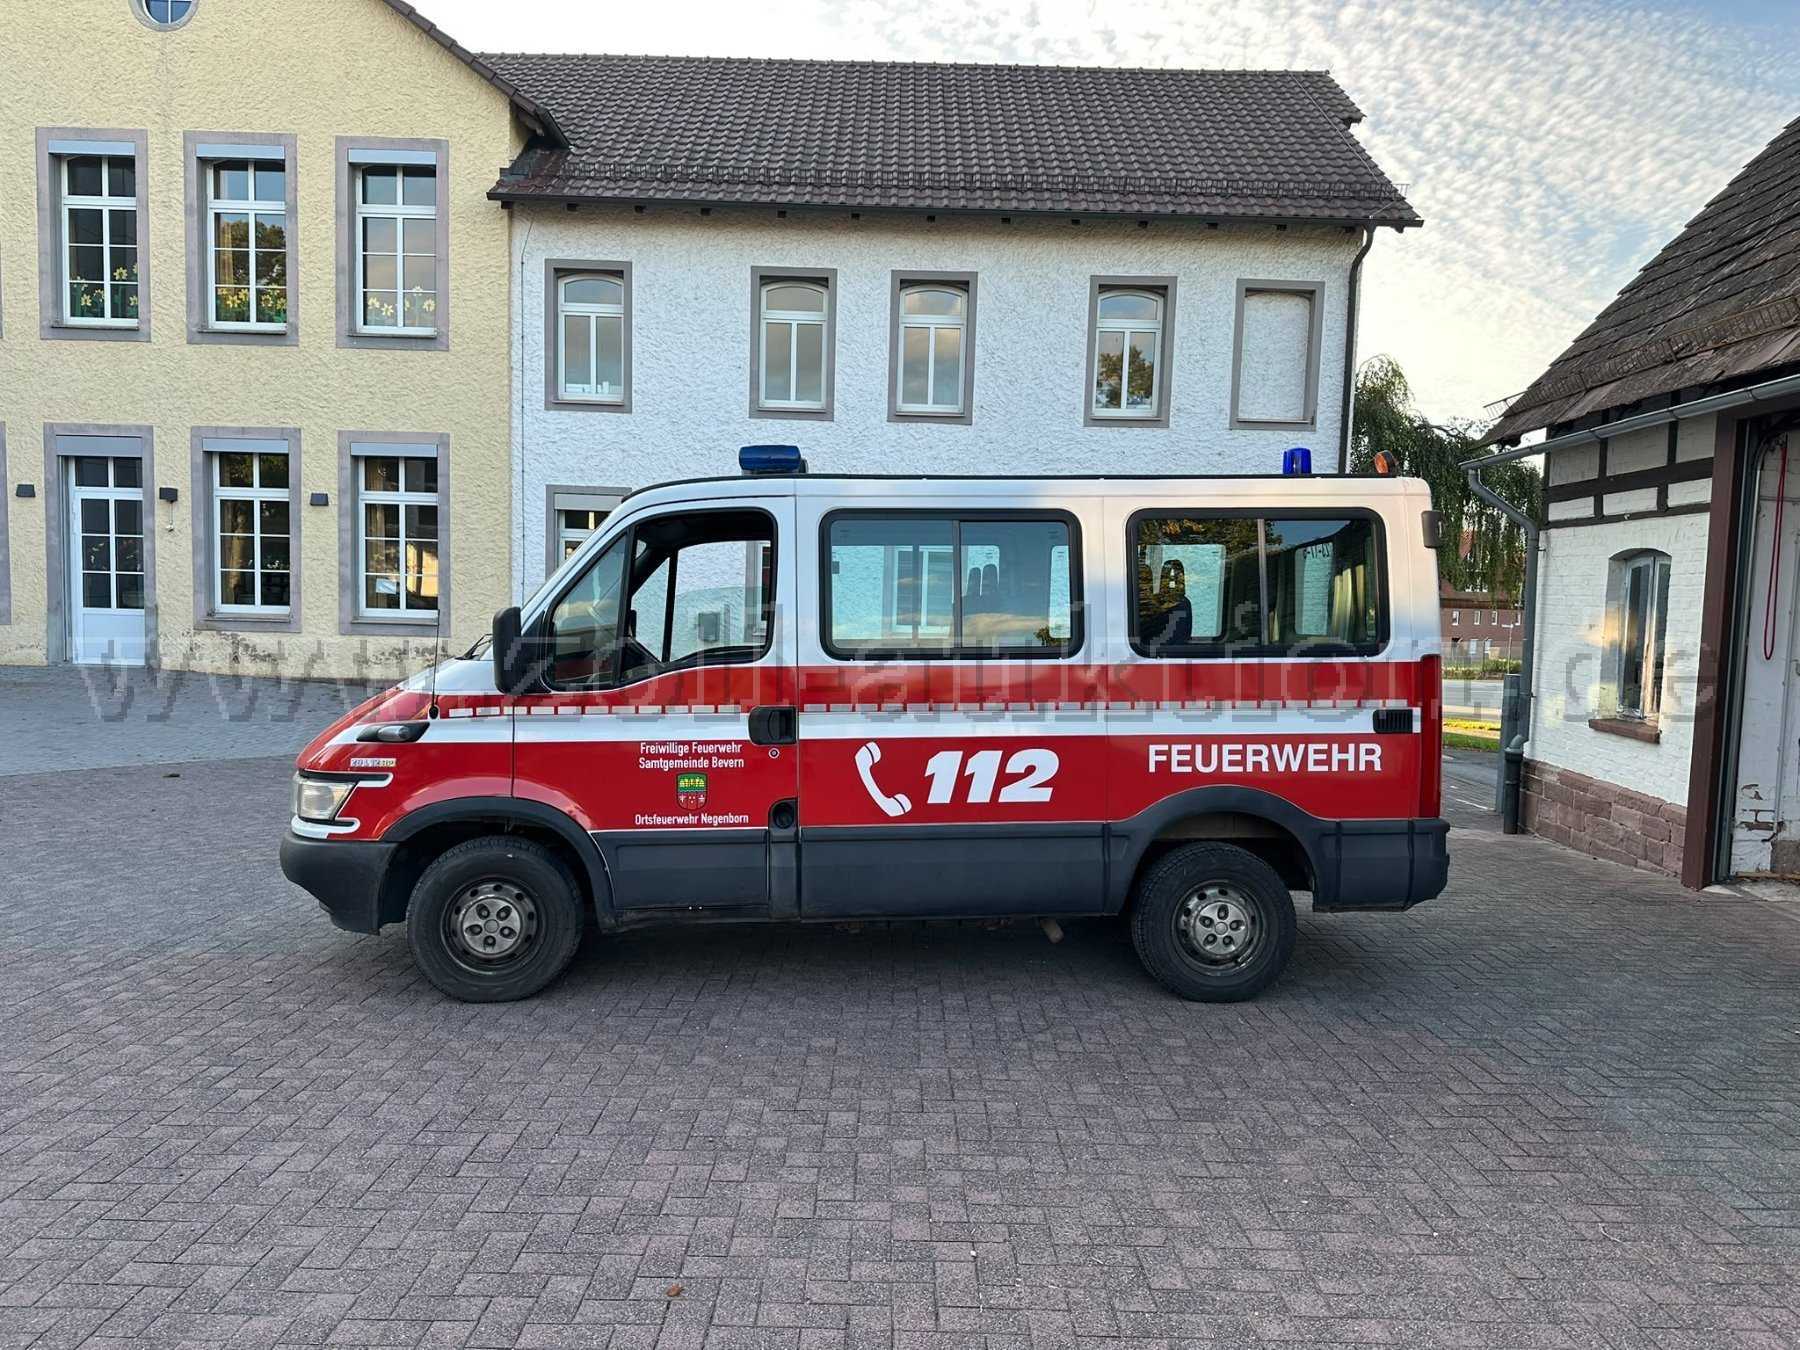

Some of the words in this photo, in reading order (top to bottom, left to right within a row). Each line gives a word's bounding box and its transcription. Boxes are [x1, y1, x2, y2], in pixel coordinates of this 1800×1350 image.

[640, 742, 689, 756] Freiwillige
[691, 741, 743, 754] Feuerwehr
[639, 757, 709, 771] Samtgemeinde
[711, 757, 745, 768] Bevern
[1148, 743, 1383, 773] FEUERWEHR
[924, 748, 1060, 803] 112
[635, 814, 699, 825] Ortsfeuerwehr
[701, 813, 749, 826] Negenborn
